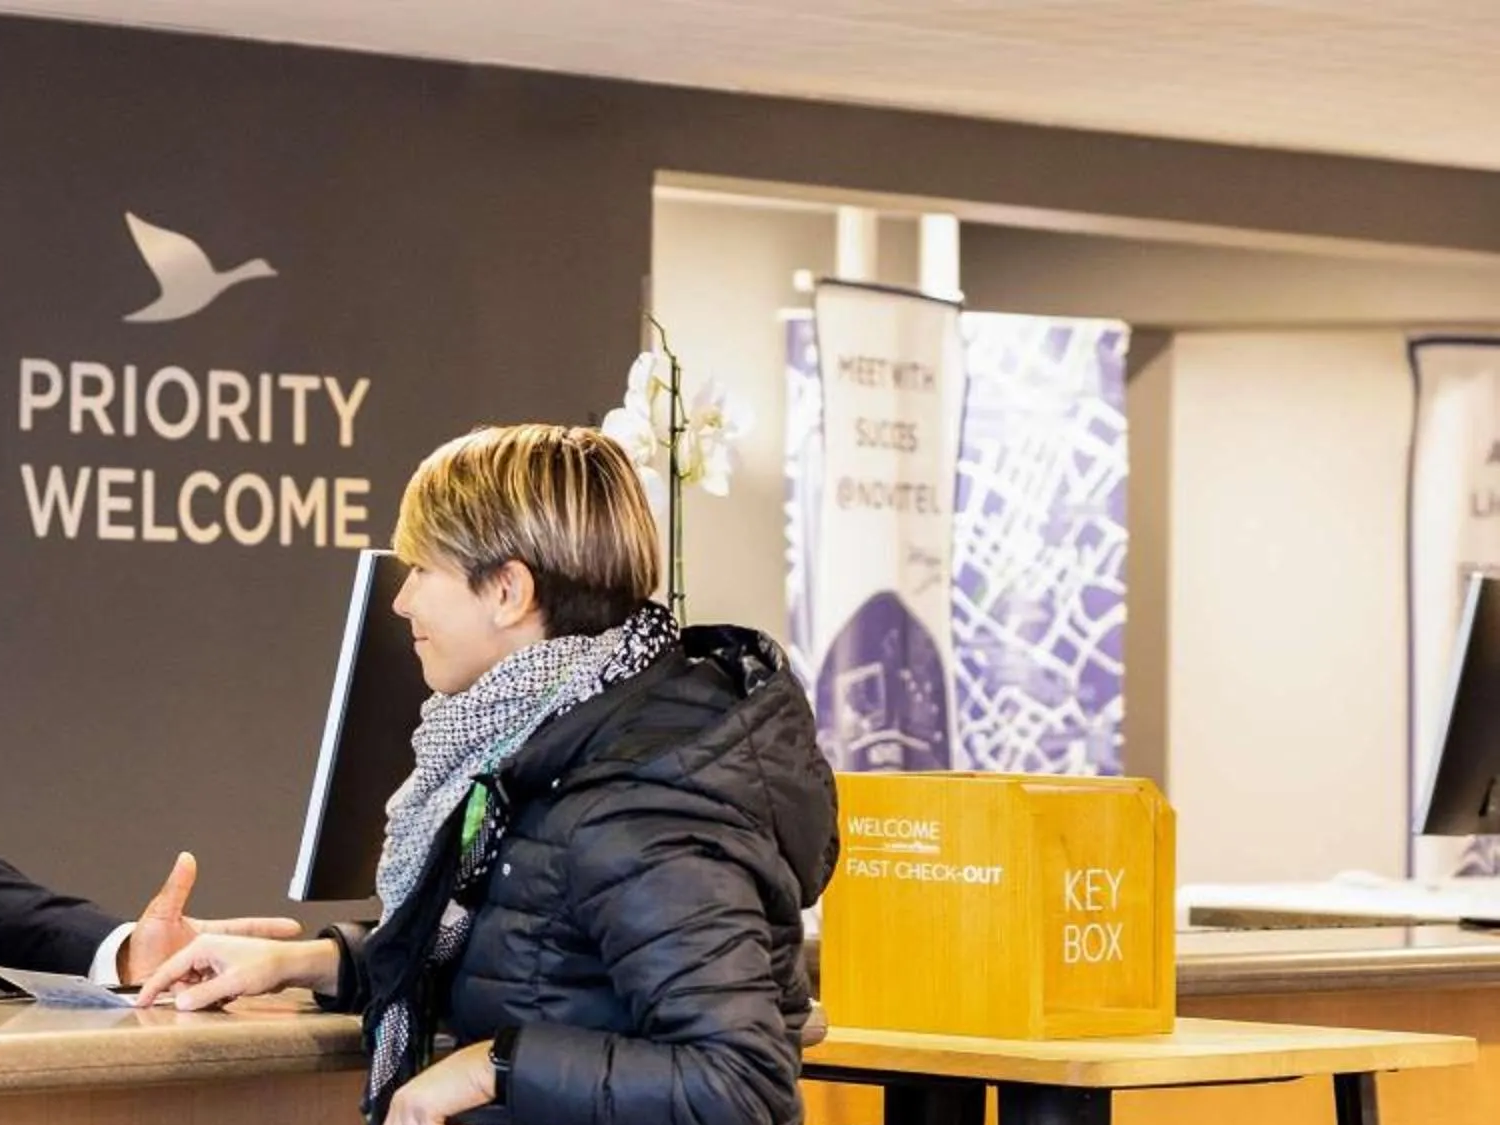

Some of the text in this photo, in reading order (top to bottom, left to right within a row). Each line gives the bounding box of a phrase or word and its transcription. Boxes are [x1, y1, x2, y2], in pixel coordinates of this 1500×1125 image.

[18, 358, 371, 448] PRIORITY
[20, 463, 371, 549] WELCOME
[848, 817, 940, 839] WELCOME
[847, 858, 1003, 884] FAST CHECK-OUT
[1064, 868, 1125, 912] KEY
[1063, 923, 1124, 963] BOX
